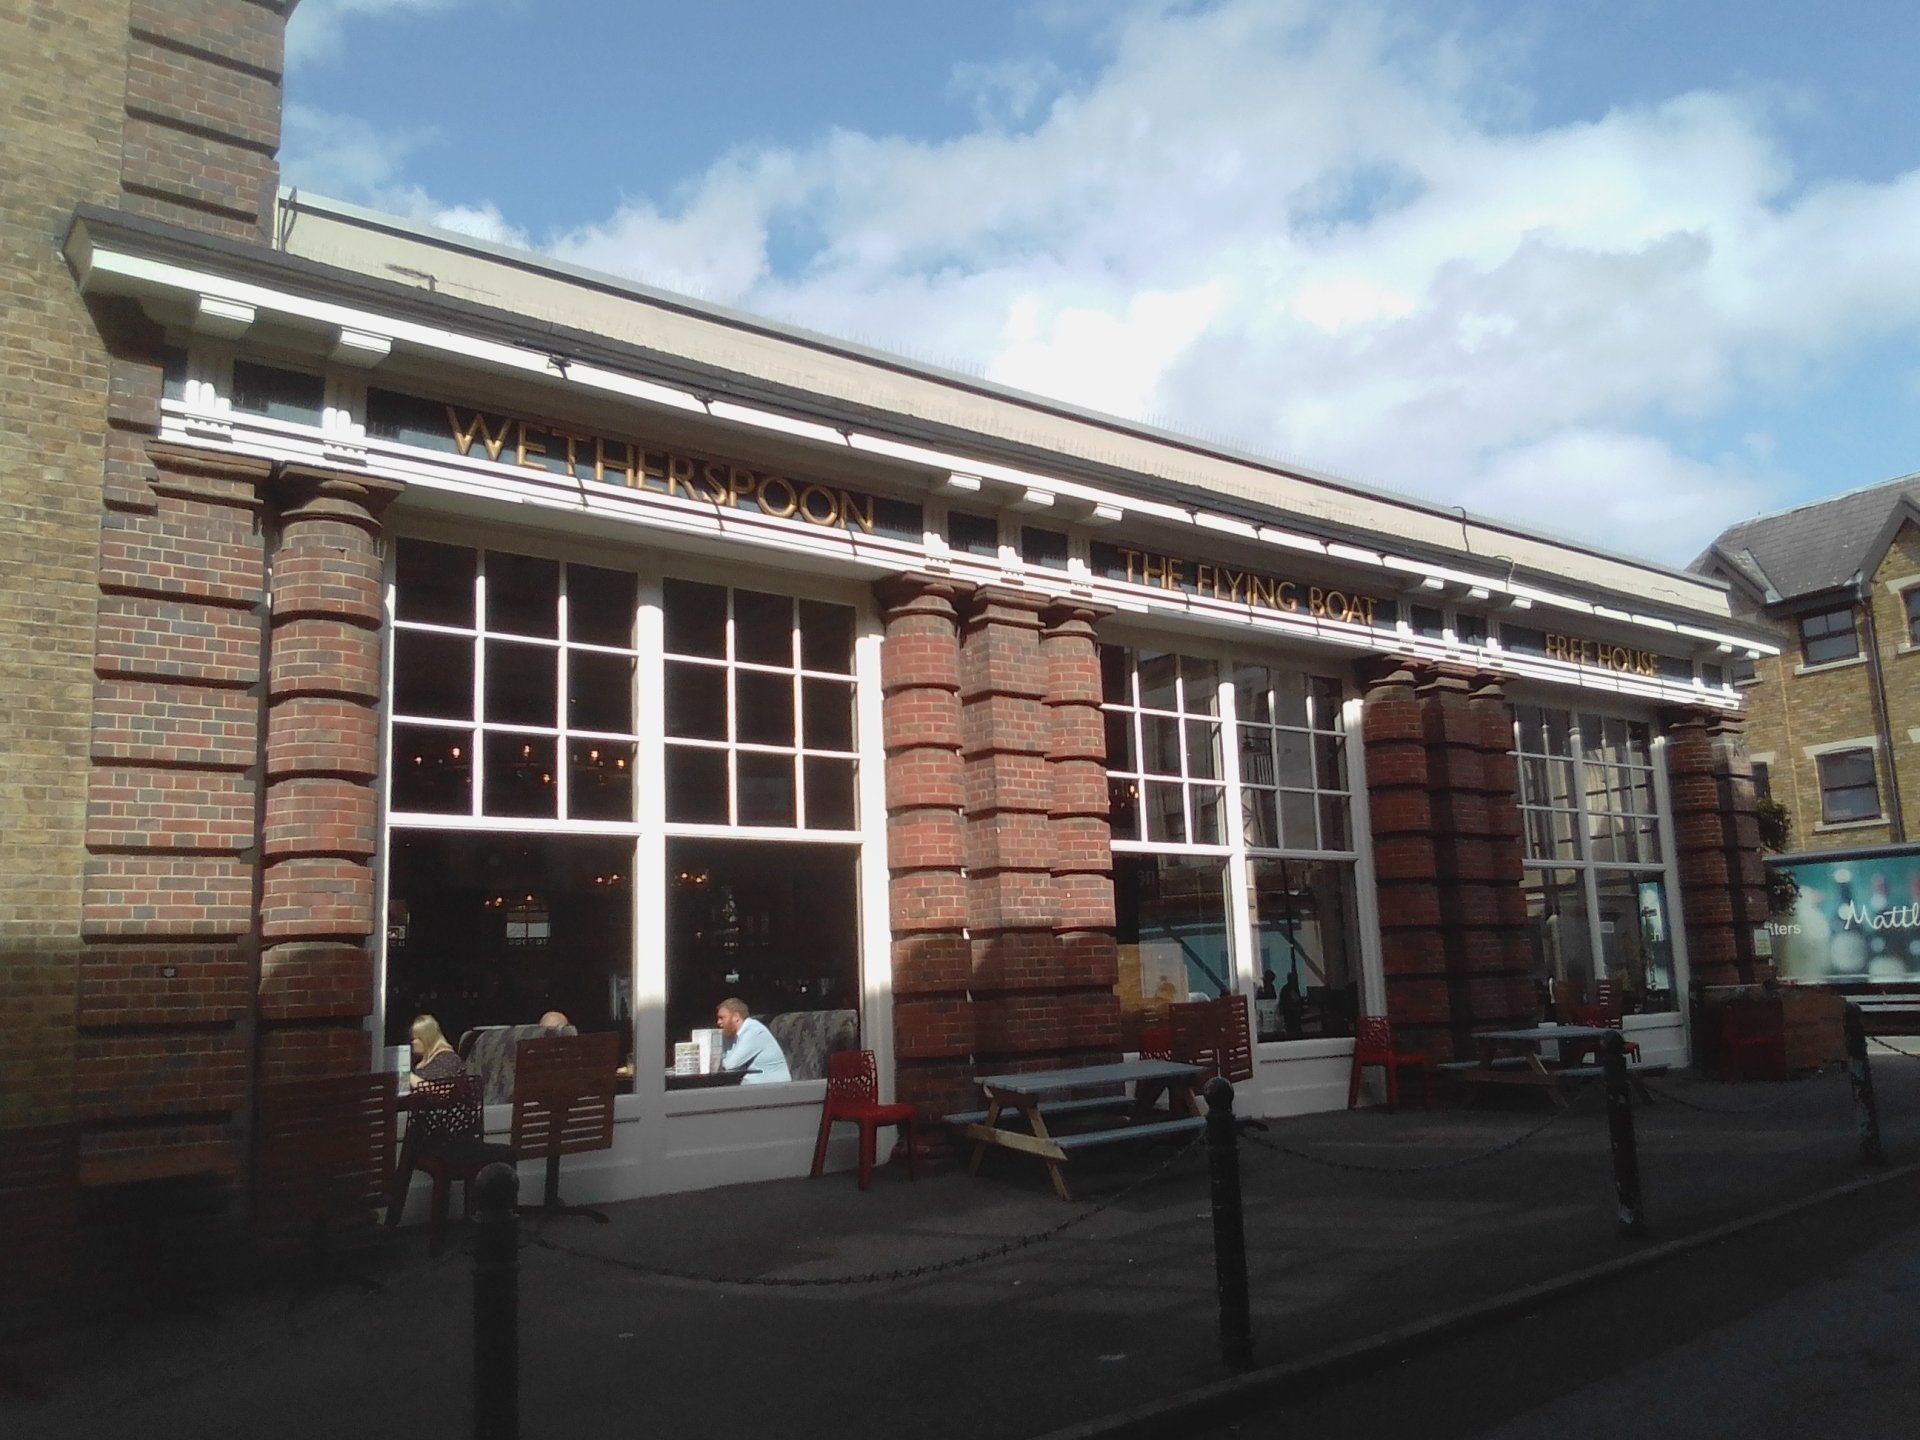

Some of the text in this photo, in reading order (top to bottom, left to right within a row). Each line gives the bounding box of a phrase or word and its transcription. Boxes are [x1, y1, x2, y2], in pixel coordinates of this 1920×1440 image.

[445, 405, 875, 534] WETHERSPOON
[1117, 549, 1378, 627] THE FLYING BOAT
[1545, 633, 1660, 677] FREE HOUSE
